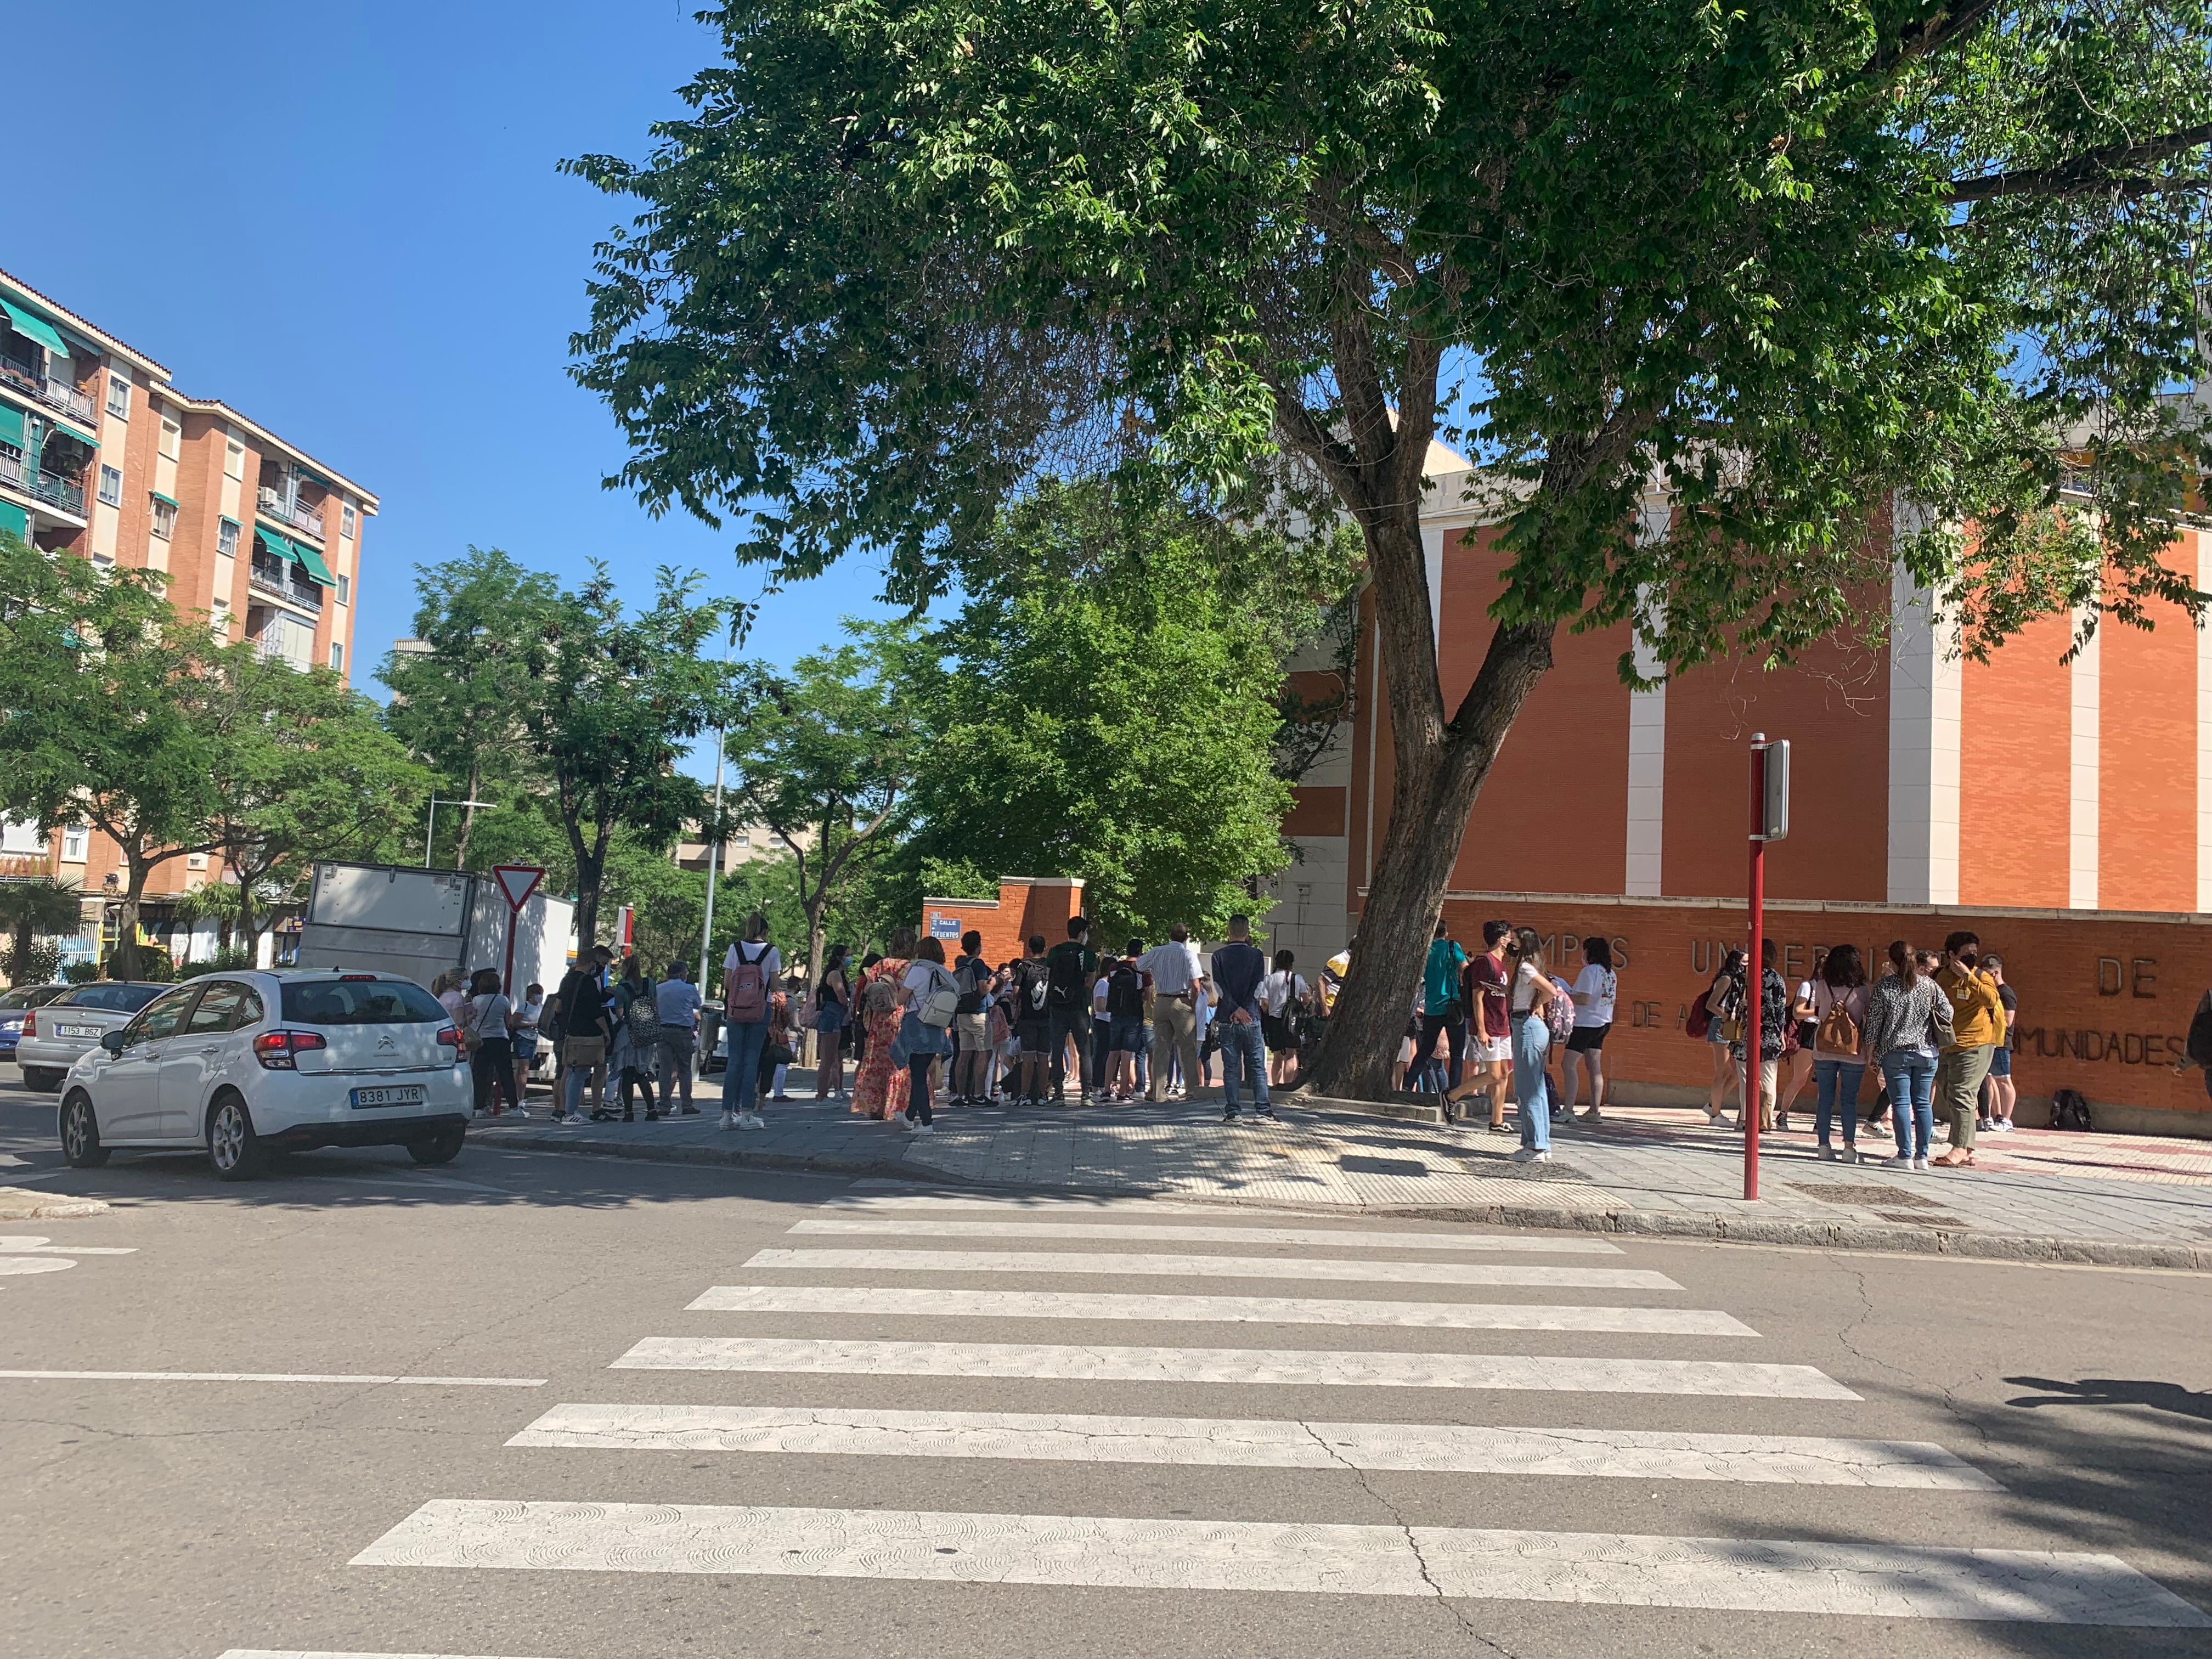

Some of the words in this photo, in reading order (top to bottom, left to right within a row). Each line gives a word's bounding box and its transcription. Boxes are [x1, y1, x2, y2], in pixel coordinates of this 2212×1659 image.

[2099, 957, 2156, 999] DE
[64, 1026, 80, 1035] 1153
[84, 1028, 99, 1036] BSZ
[1632, 1000, 1662, 1029] DE
[2014, 1026, 2185, 1067] MUNIDADES
[360, 1090, 390, 1103] 8381
[397, 1088, 419, 1101] JYR
